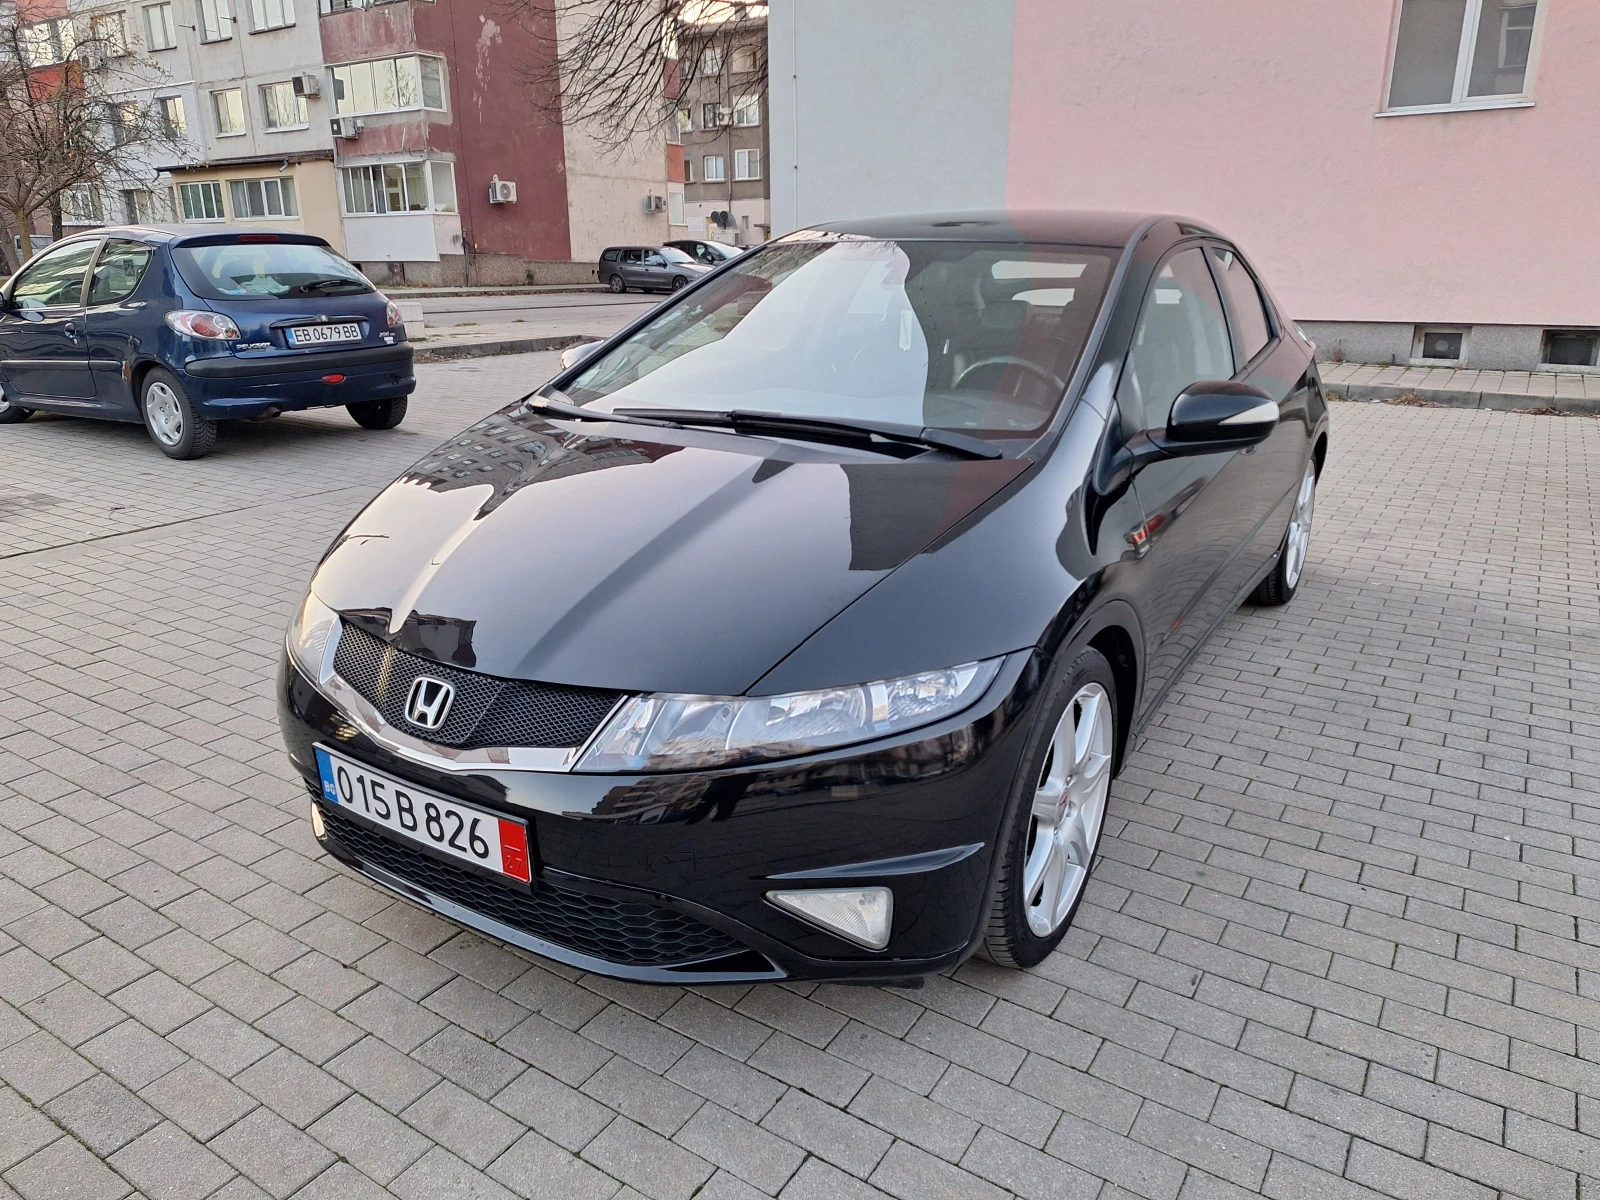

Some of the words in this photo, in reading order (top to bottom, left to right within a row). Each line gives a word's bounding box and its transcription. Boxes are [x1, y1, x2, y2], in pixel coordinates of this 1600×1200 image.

[294, 329, 312, 342] EB
[312, 326, 341, 341] 0679
[342, 325, 359, 339] BB
[236, 342, 271, 350] PEUGEOT
[323, 780, 336, 796] BG
